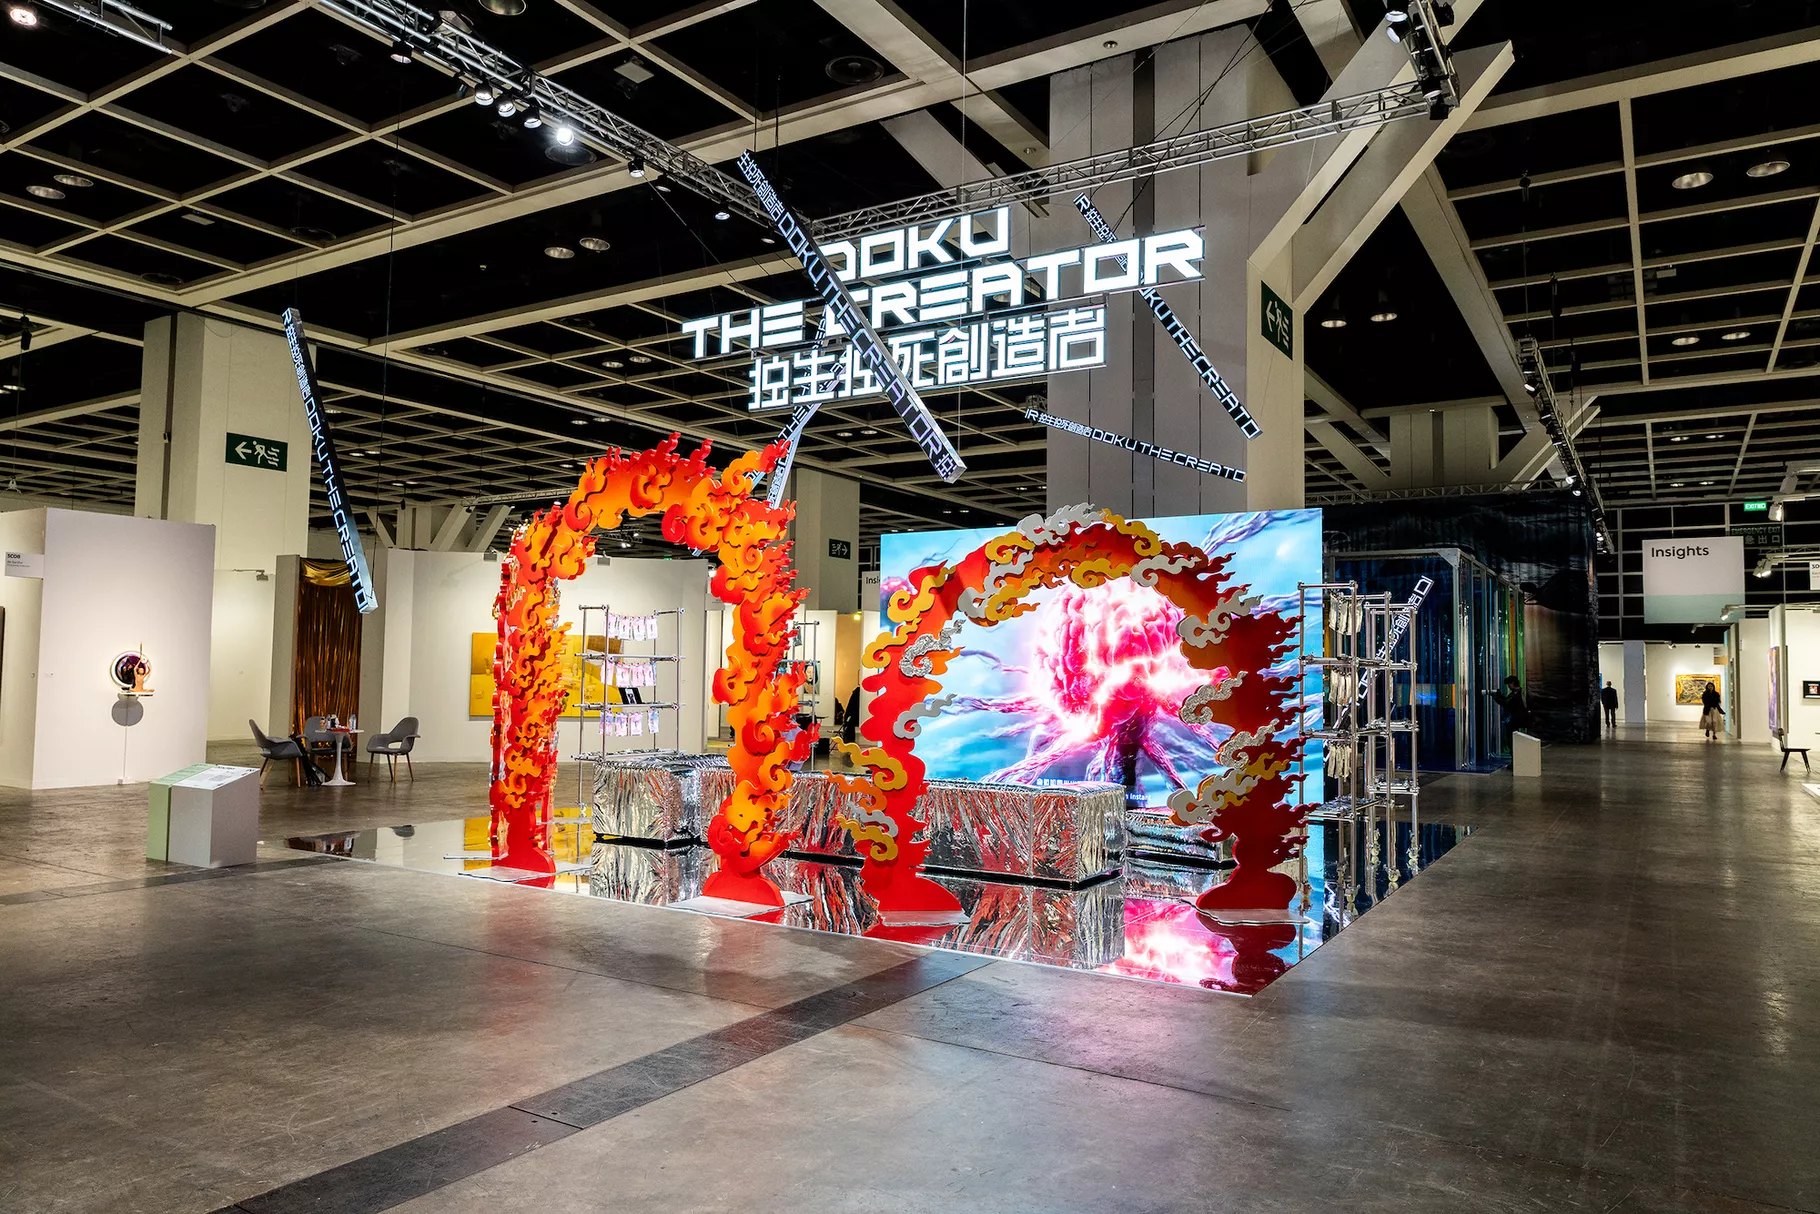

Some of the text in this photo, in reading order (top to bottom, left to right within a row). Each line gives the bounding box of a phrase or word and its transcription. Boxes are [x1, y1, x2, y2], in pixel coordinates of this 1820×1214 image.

[818, 206, 1010, 281] DOKU
[681, 300, 803, 359] THE
[777, 212, 826, 285] DOKU
[822, 274, 861, 336] THE
[851, 328, 943, 459] CREATOR
[1166, 315, 1201, 360] THE
[1191, 356, 1261, 439] CREATO
[1092, 428, 1247, 483] DOKU THE CREATO
[305, 397, 369, 613] DOKU THE CREATO
[1768, 526, 1781, 534] EXIT
[1651, 546, 1709, 559] Insights
[1744, 535, 1780, 545] 急出口
[866, 576, 880, 585] Insi
